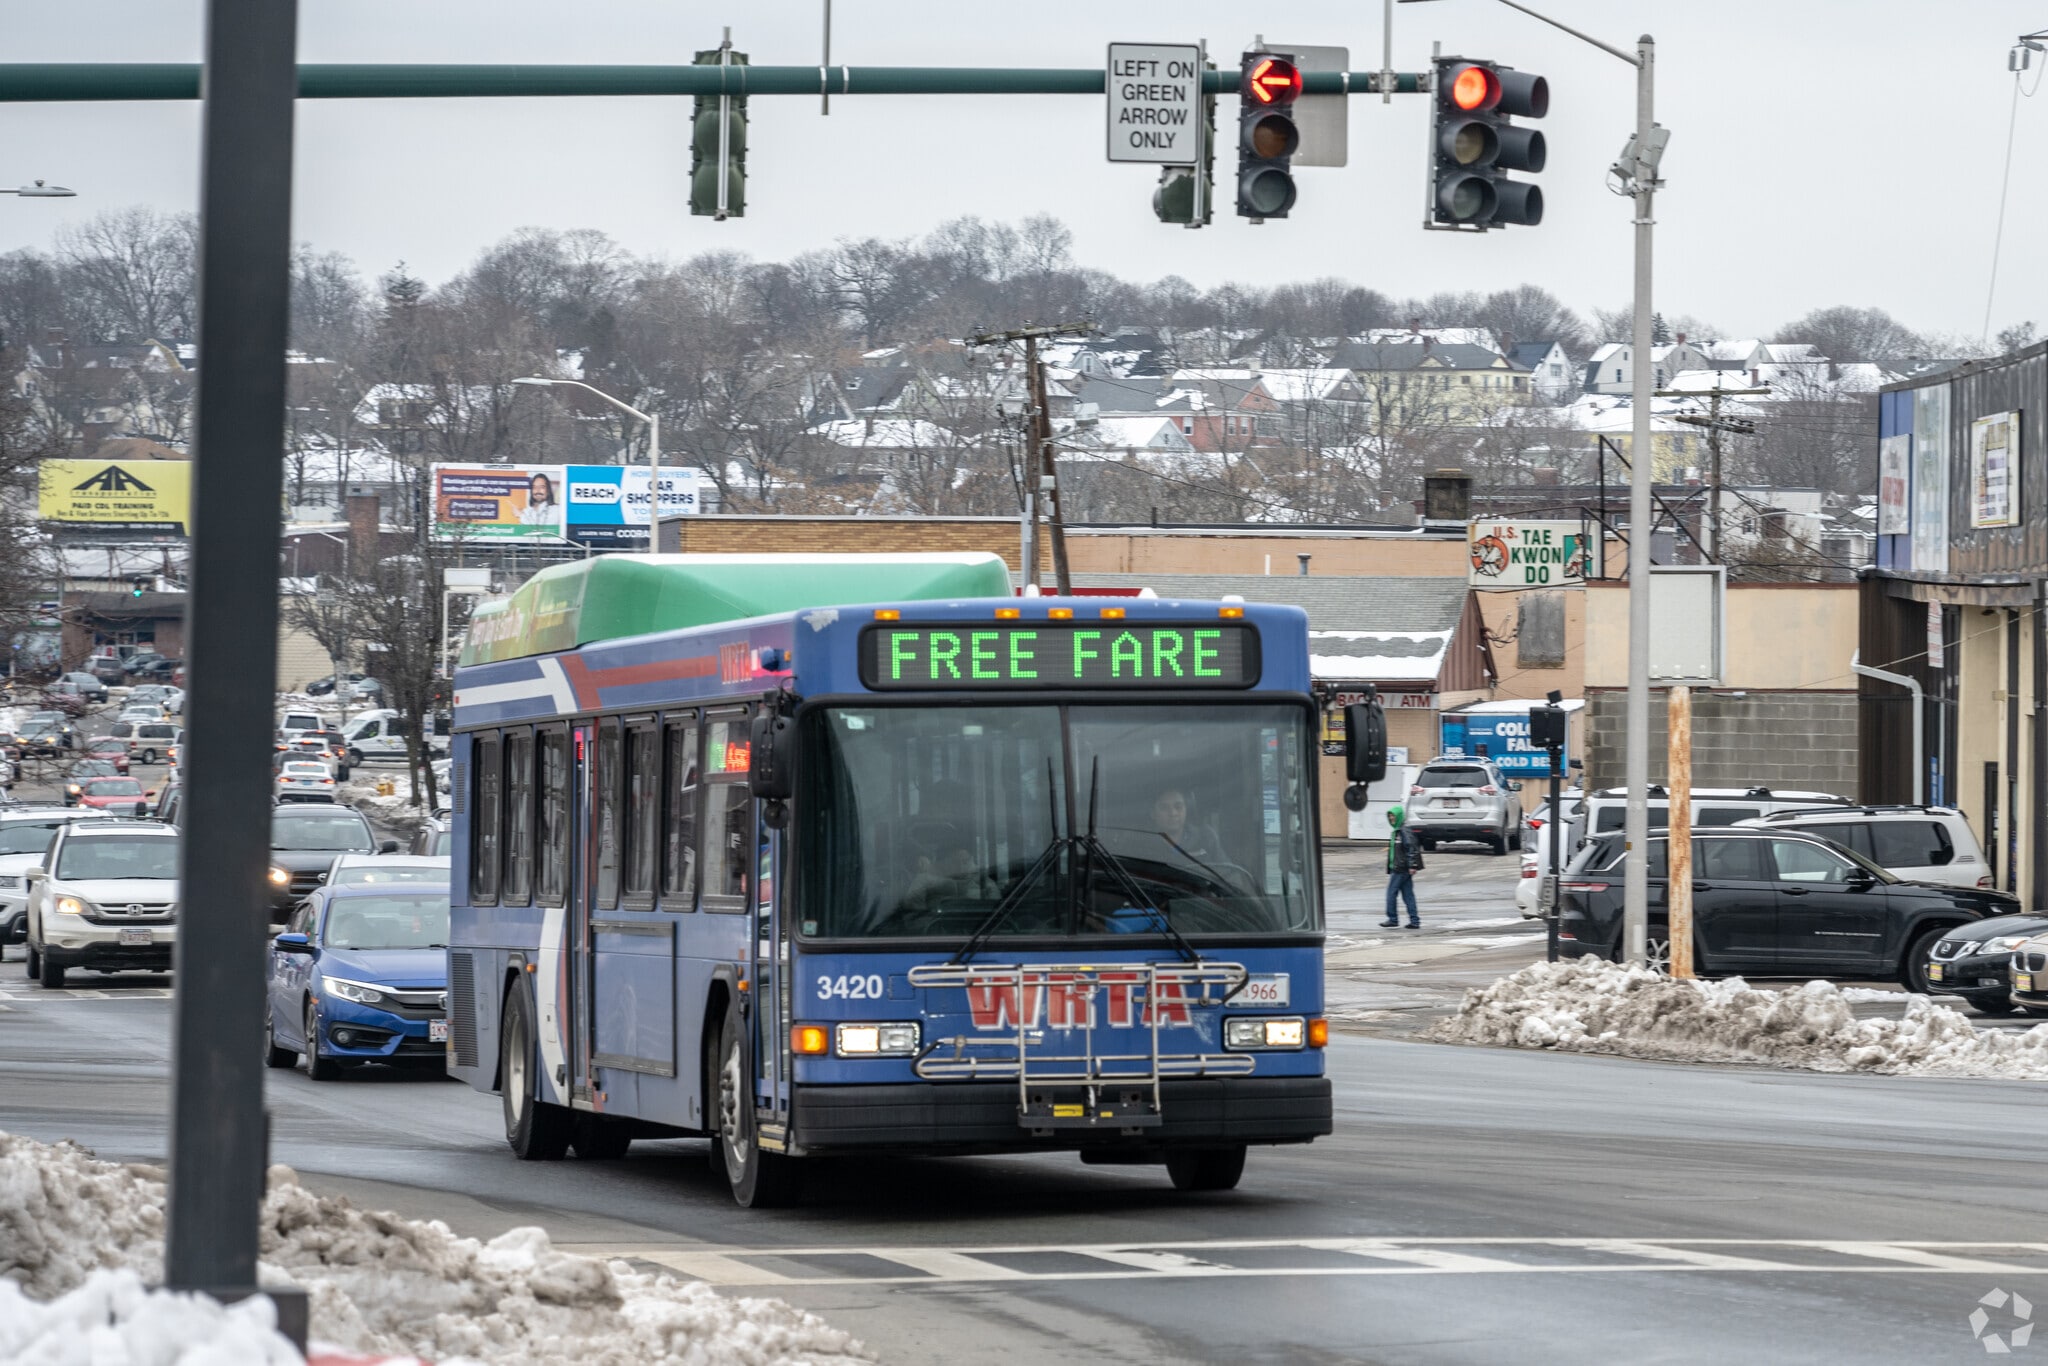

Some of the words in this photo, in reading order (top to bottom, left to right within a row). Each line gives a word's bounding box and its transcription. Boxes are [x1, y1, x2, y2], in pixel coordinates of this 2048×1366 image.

[1114, 60, 1159, 77] LEFT
[1167, 61, 1194, 78] ON
[1122, 83, 1186, 101] GREEN
[1119, 107, 1188, 125] ARROW
[1129, 131, 1176, 148] ONLY
[631, 471, 692, 479] HOMBUYERS
[575, 488, 615, 498] REACH
[1493, 526, 1518, 539] U.S.
[1521, 529, 1552, 545] TAE
[1511, 547, 1562, 564] KWON
[1525, 566, 1550, 584] DO
[891, 633, 1038, 679] FREE
[1073, 630, 1221, 678] FARE
[1401, 695, 1431, 708] ATM
[1496, 756, 1529, 767] COLD
[817, 975, 883, 999] 3420
[1251, 983, 1278, 1000] 966
[966, 973, 1193, 1030] WRTA
